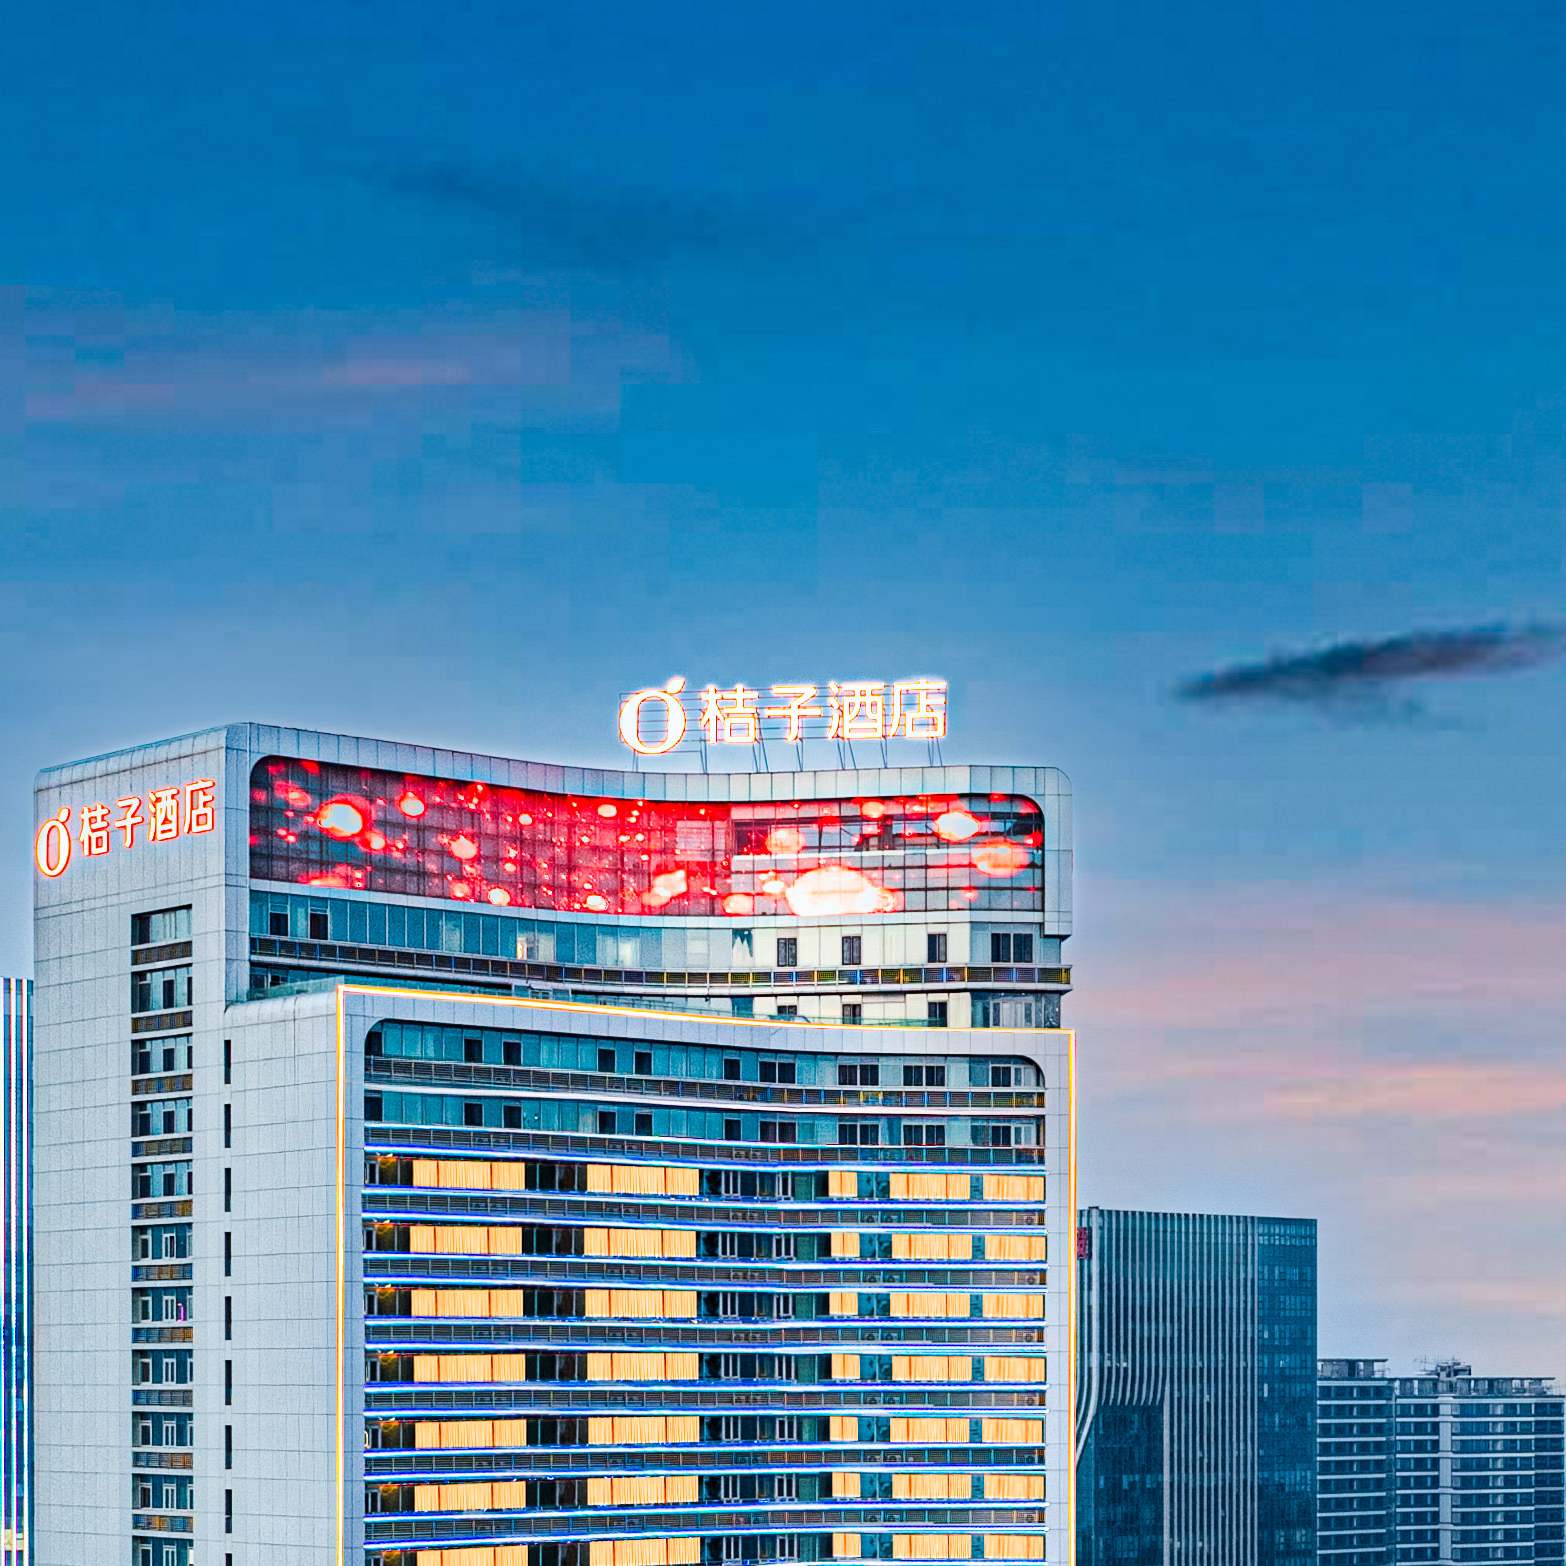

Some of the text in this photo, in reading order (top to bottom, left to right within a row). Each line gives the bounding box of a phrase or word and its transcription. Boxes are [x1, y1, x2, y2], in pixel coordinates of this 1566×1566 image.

[699, 679, 948, 745] 桔子酒店
[78, 778, 216, 857] 桔子酒店
